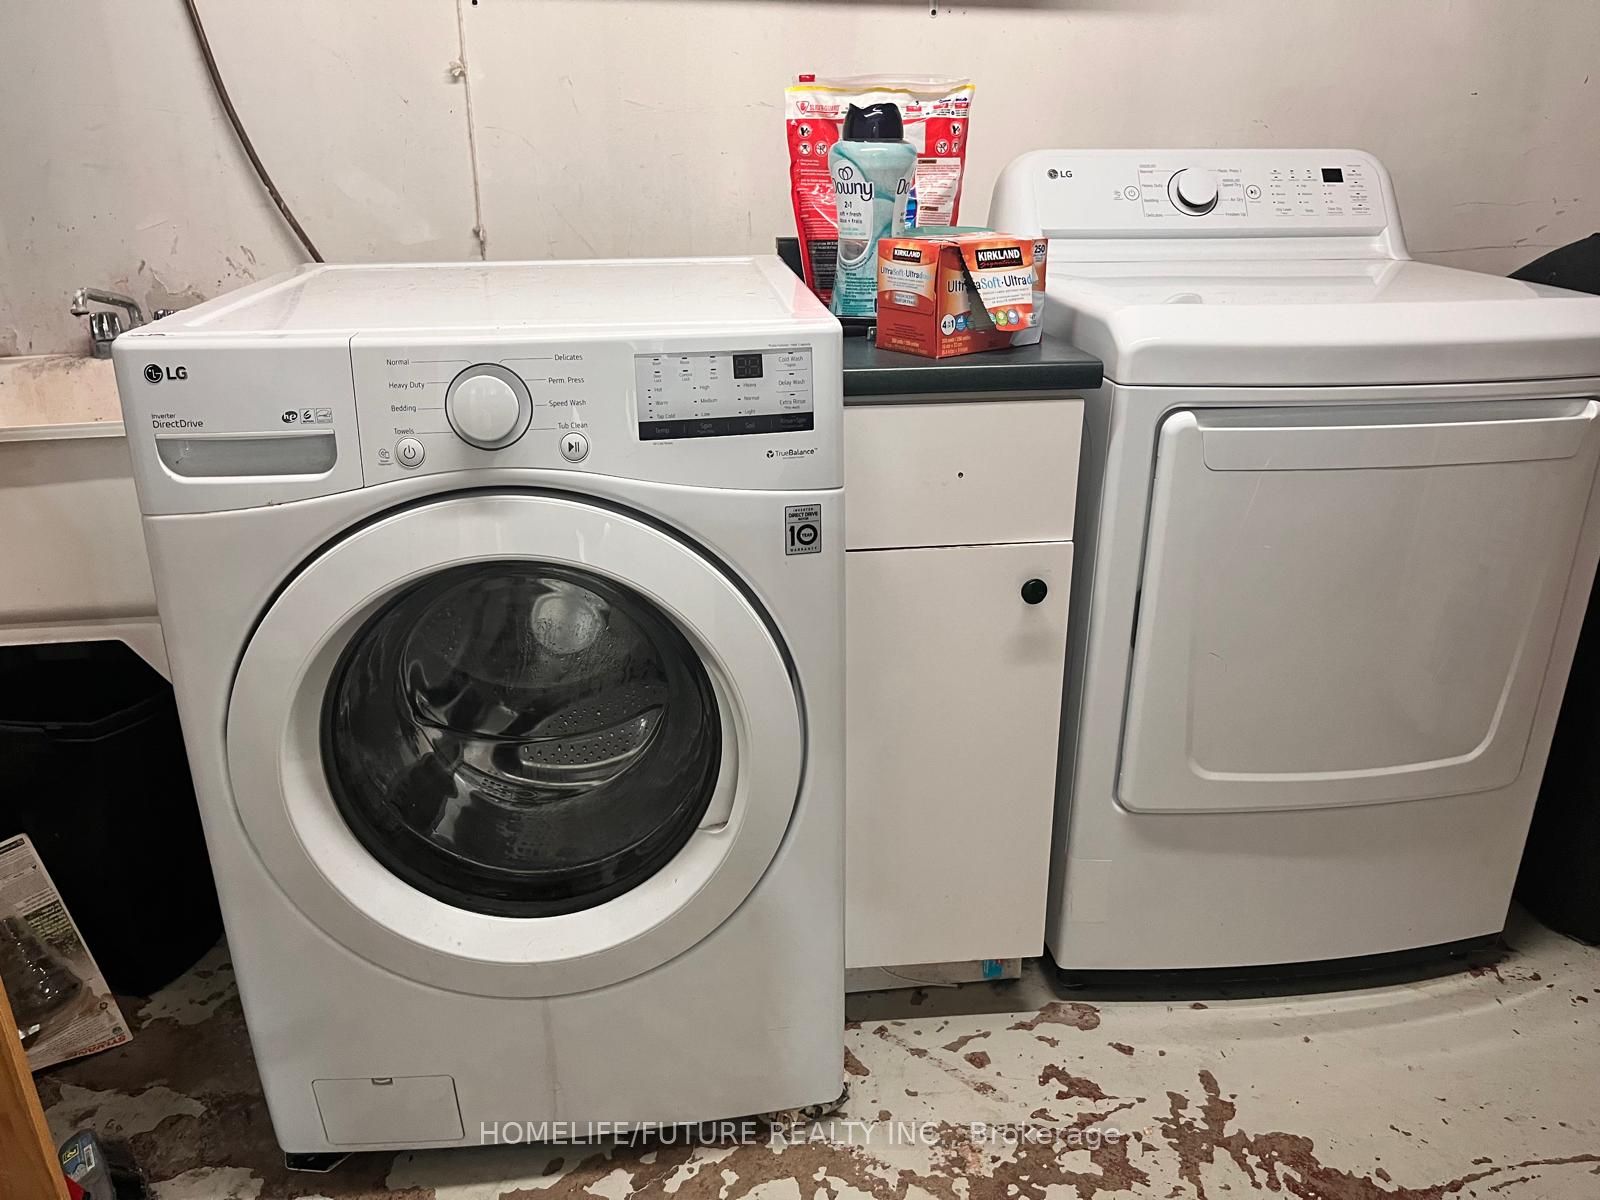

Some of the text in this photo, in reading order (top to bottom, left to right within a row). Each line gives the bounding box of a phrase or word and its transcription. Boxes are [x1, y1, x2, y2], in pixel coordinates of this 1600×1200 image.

[1060, 170, 1073, 178] LG
[894, 249, 921, 258] KIRKLAND
[1034, 244, 1046, 254] 250
[978, 248, 1020, 262] KIRKLAND
[554, 353, 583, 361] Delicates
[166, 366, 188, 380] LG
[567, 375, 585, 383] Press
[388, 380, 425, 390] Heavy Duty
[549, 399, 568, 408] Speed
[391, 404, 417, 413] Bedding
[151, 412, 176, 420] Inverter
[152, 419, 204, 429] DirectDrive
[557, 421, 588, 430] Tub Clean
[394, 427, 415, 435] Towels
[789, 524, 818, 546] 10
